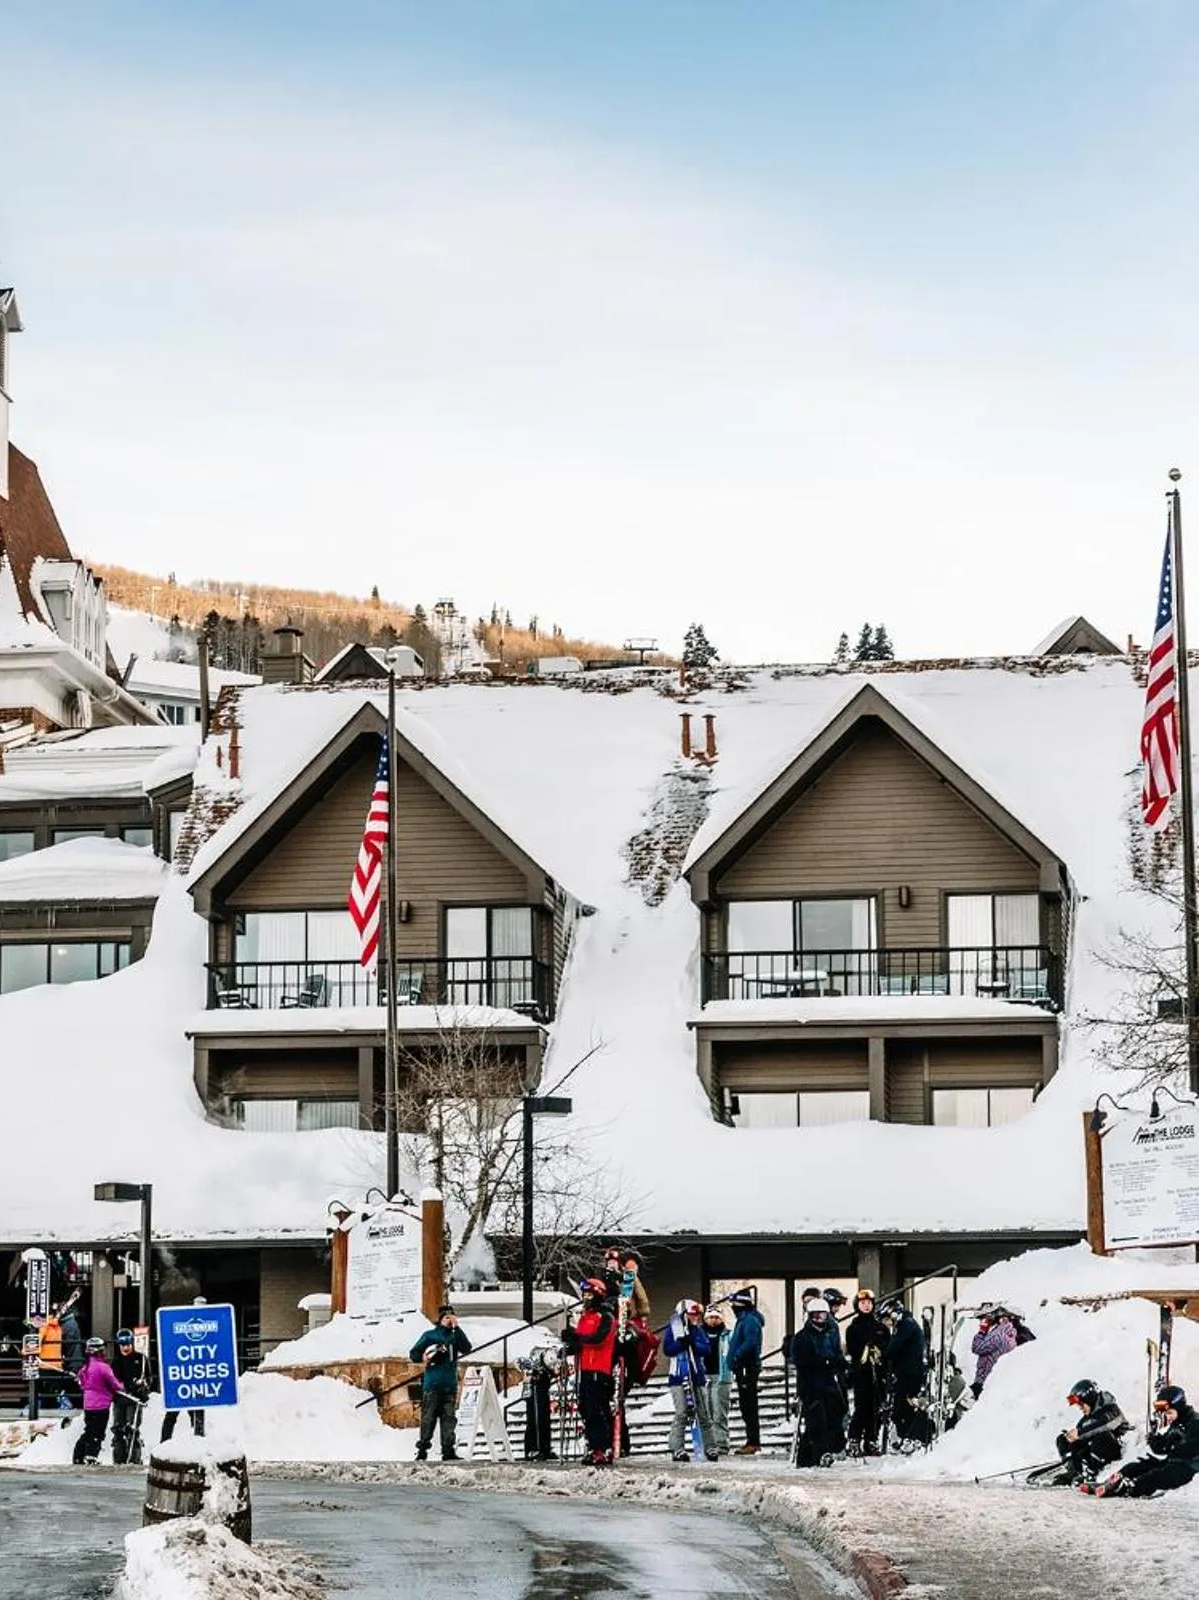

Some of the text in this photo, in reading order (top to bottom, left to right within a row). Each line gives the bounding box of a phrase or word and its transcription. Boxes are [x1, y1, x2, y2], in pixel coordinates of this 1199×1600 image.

[1170, 1124, 1194, 1136] LODGE
[177, 1344, 217, 1361] CITY
[168, 1362, 230, 1380] BUSES
[177, 1382, 222, 1399] ONLY
